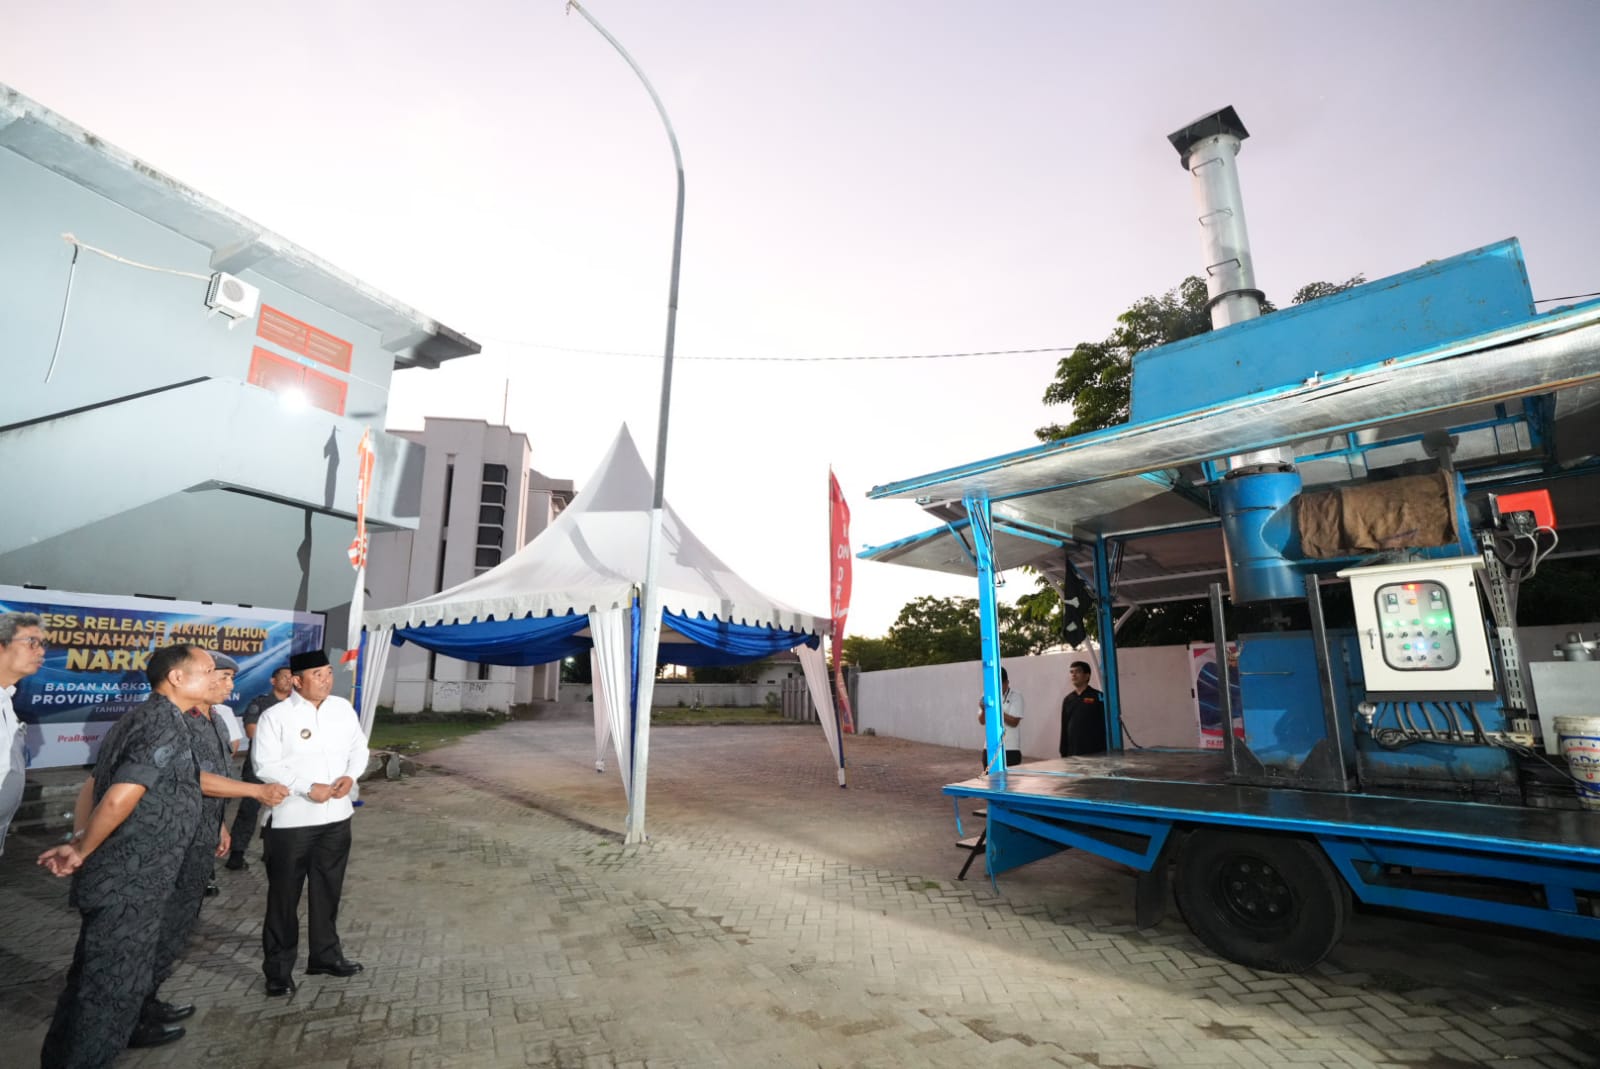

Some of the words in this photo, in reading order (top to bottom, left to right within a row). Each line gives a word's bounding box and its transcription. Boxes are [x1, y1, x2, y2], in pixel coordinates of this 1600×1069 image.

[26, 612, 78, 628] ESS
[84, 616, 166, 633] RELEASE
[171, 623, 219, 637] AKHIR
[224, 626, 268, 640] TAHUN
[43, 630, 150, 647] MUSNAHAN
[223, 640, 264, 652] BUKTI
[65, 648, 151, 670] NARK
[45, 682, 97, 692] BADAN
[31, 694, 109, 705] PROVINSI
